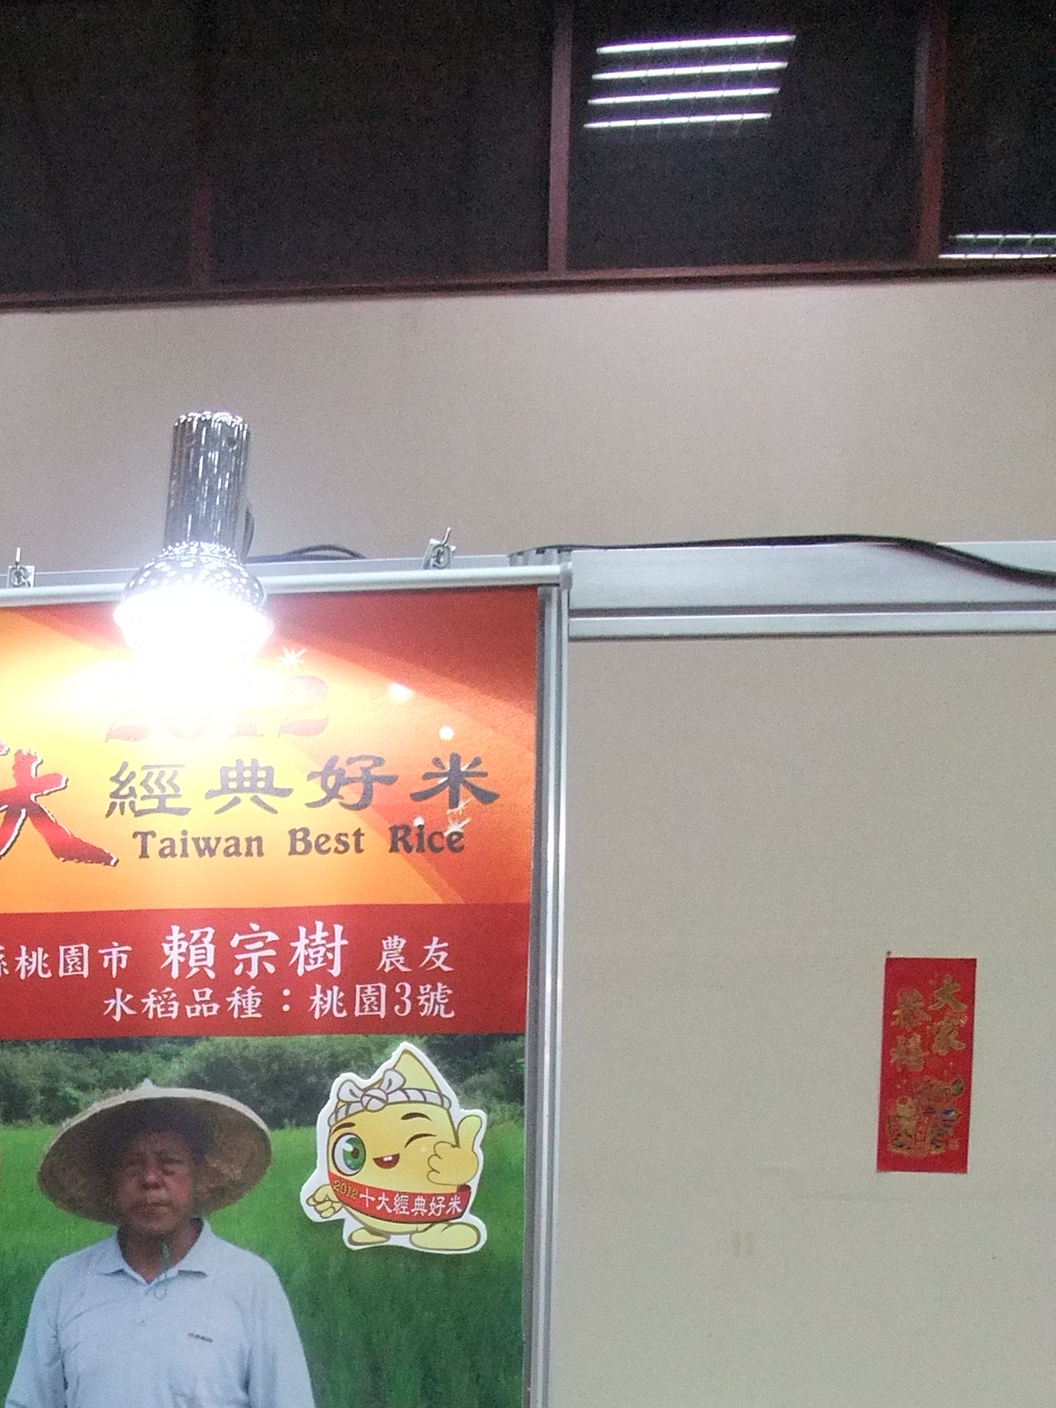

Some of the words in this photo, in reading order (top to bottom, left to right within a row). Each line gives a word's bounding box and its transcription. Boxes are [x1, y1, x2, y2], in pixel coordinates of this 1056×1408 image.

[104, 752, 501, 820] 經典好米
[131, 829, 265, 860] Taiwan
[288, 826, 366, 857] Best
[388, 822, 465, 854] Rice
[160, 921, 351, 980] 賴宗樹
[376, 935, 455, 974] 農友
[103, 981, 456, 1023] 水稻品種：桃園3號
[359, 1188, 463, 1217] 十大經典好米
